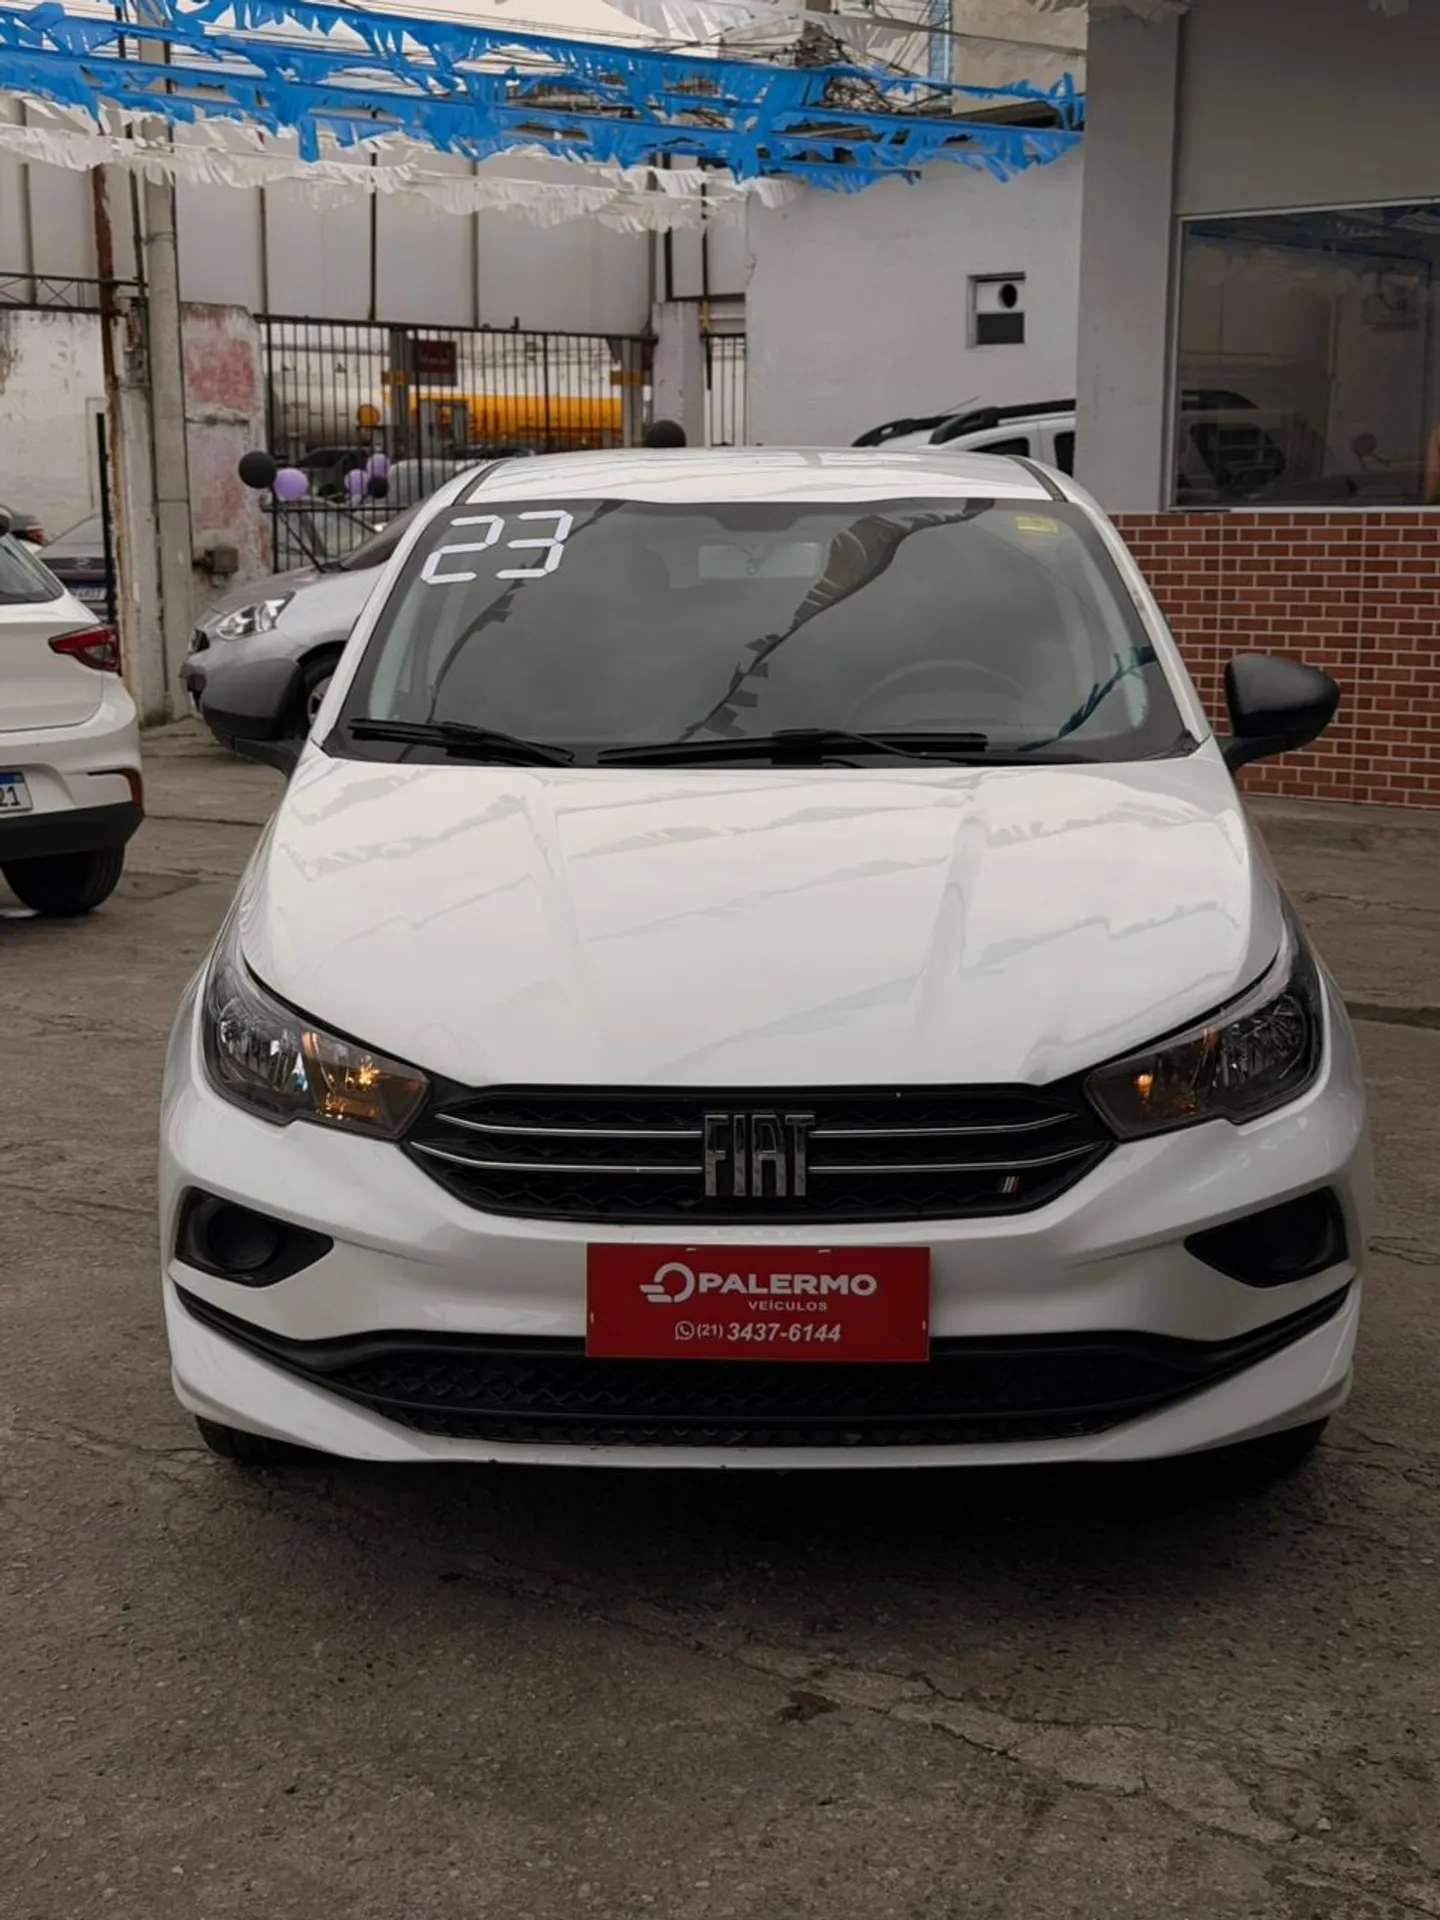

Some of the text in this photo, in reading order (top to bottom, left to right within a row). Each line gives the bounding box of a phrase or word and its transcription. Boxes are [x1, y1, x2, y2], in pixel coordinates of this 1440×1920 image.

[420, 510, 574, 585] 23
[704, 1113, 815, 1197] FIAT
[700, 1273, 878, 1296] PALERMO
[748, 1300, 828, 1312] VEÍCULOS
[697, 1322, 842, 1342] (21) 3437-6144
